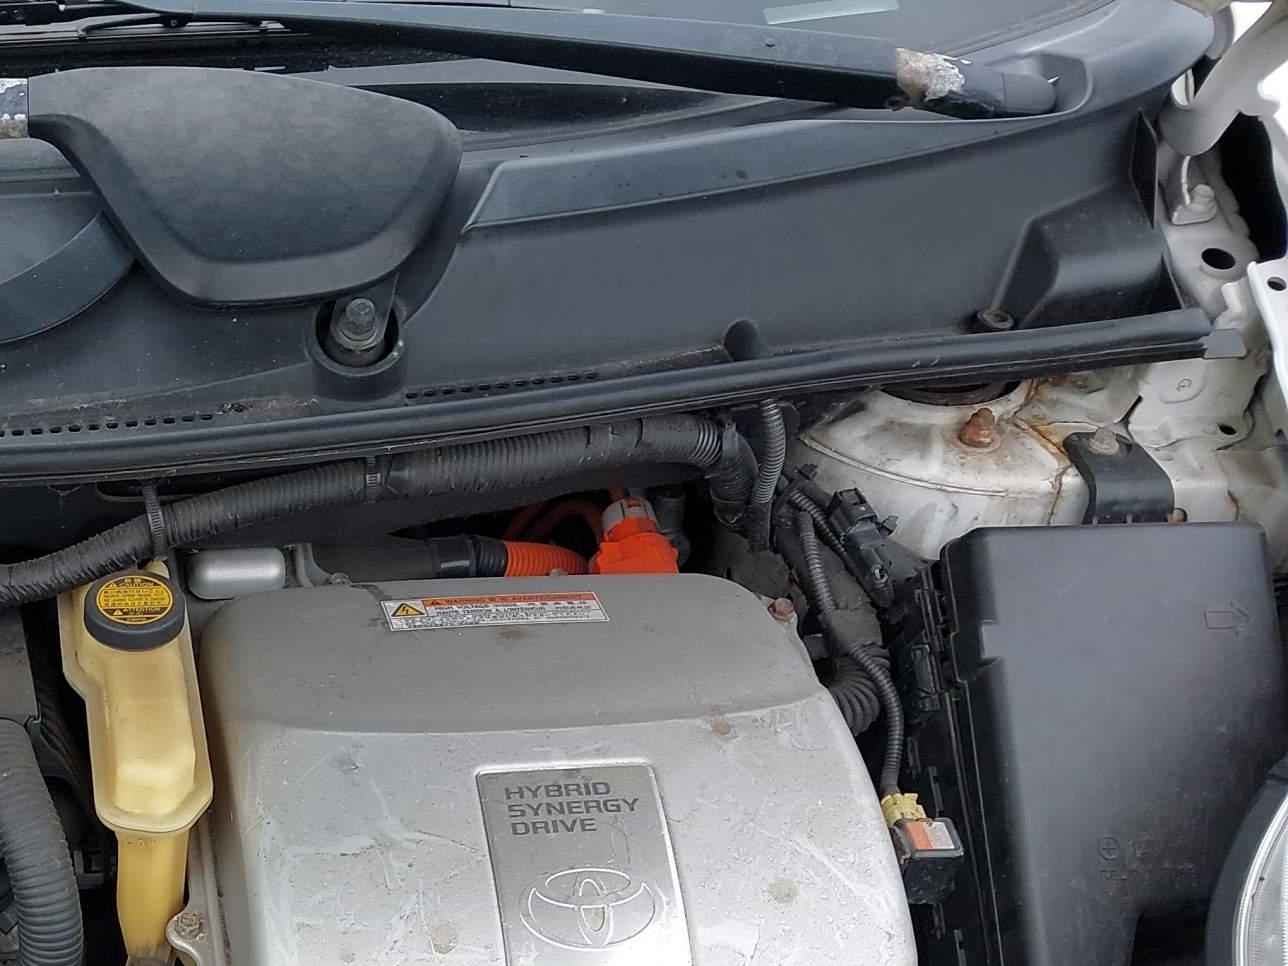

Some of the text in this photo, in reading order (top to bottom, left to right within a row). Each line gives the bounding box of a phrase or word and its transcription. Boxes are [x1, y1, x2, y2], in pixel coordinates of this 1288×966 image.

[504, 782, 611, 800] HYBRID
[508, 798, 640, 818] SYNERGY
[511, 818, 597, 835] DRIVE
